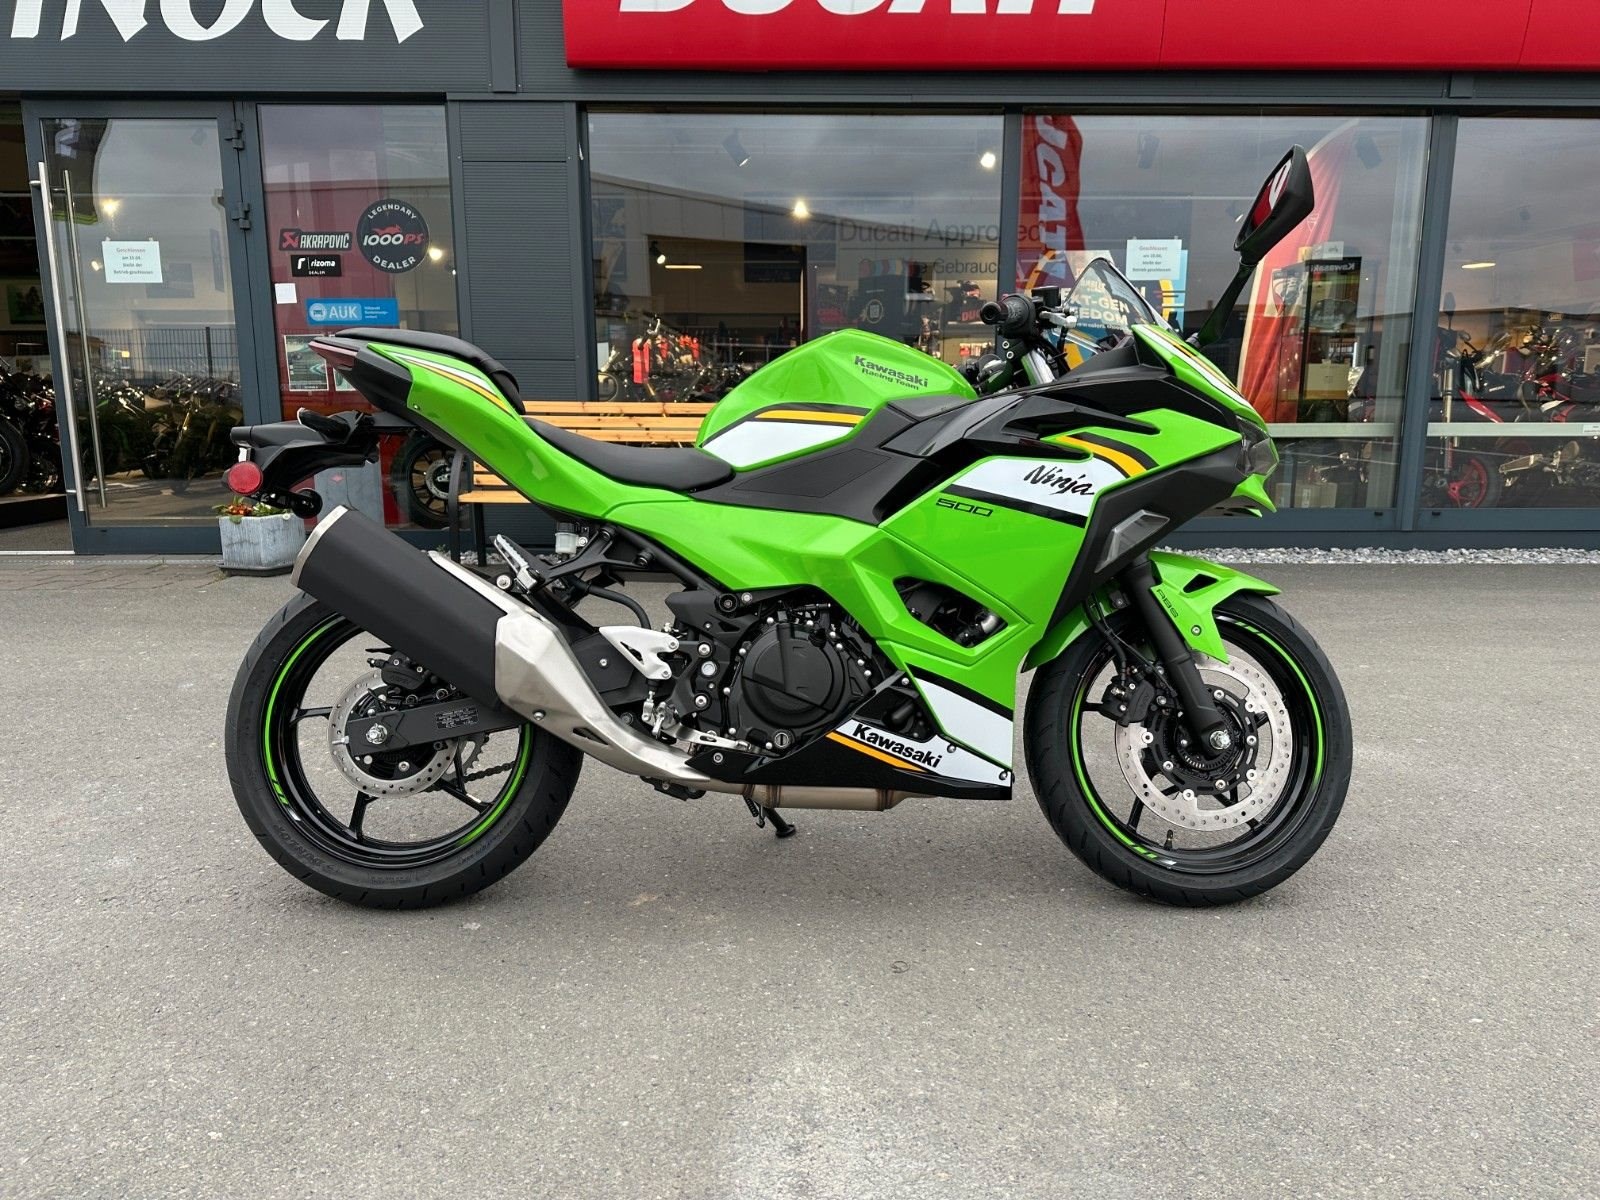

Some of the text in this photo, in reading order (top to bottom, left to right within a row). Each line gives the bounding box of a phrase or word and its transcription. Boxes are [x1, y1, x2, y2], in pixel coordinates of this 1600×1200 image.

[1035, 115, 1068, 279] UCATI
[368, 203, 417, 220] LEGENDARY
[363, 232, 424, 246] 1000PS
[840, 218, 1043, 247] Ducati Approed
[310, 257, 336, 267] rizoma
[372, 255, 417, 270] DEALER
[933, 257, 999, 274] Gebrauc
[329, 305, 358, 319] AUK
[854, 355, 928, 388] Kawasaki
[862, 368, 919, 391] Racing Team
[1023, 464, 1095, 496] Ninja
[935, 497, 994, 518] 500
[1156, 588, 1179, 618] ABS
[852, 723, 943, 769] Kawasaki
